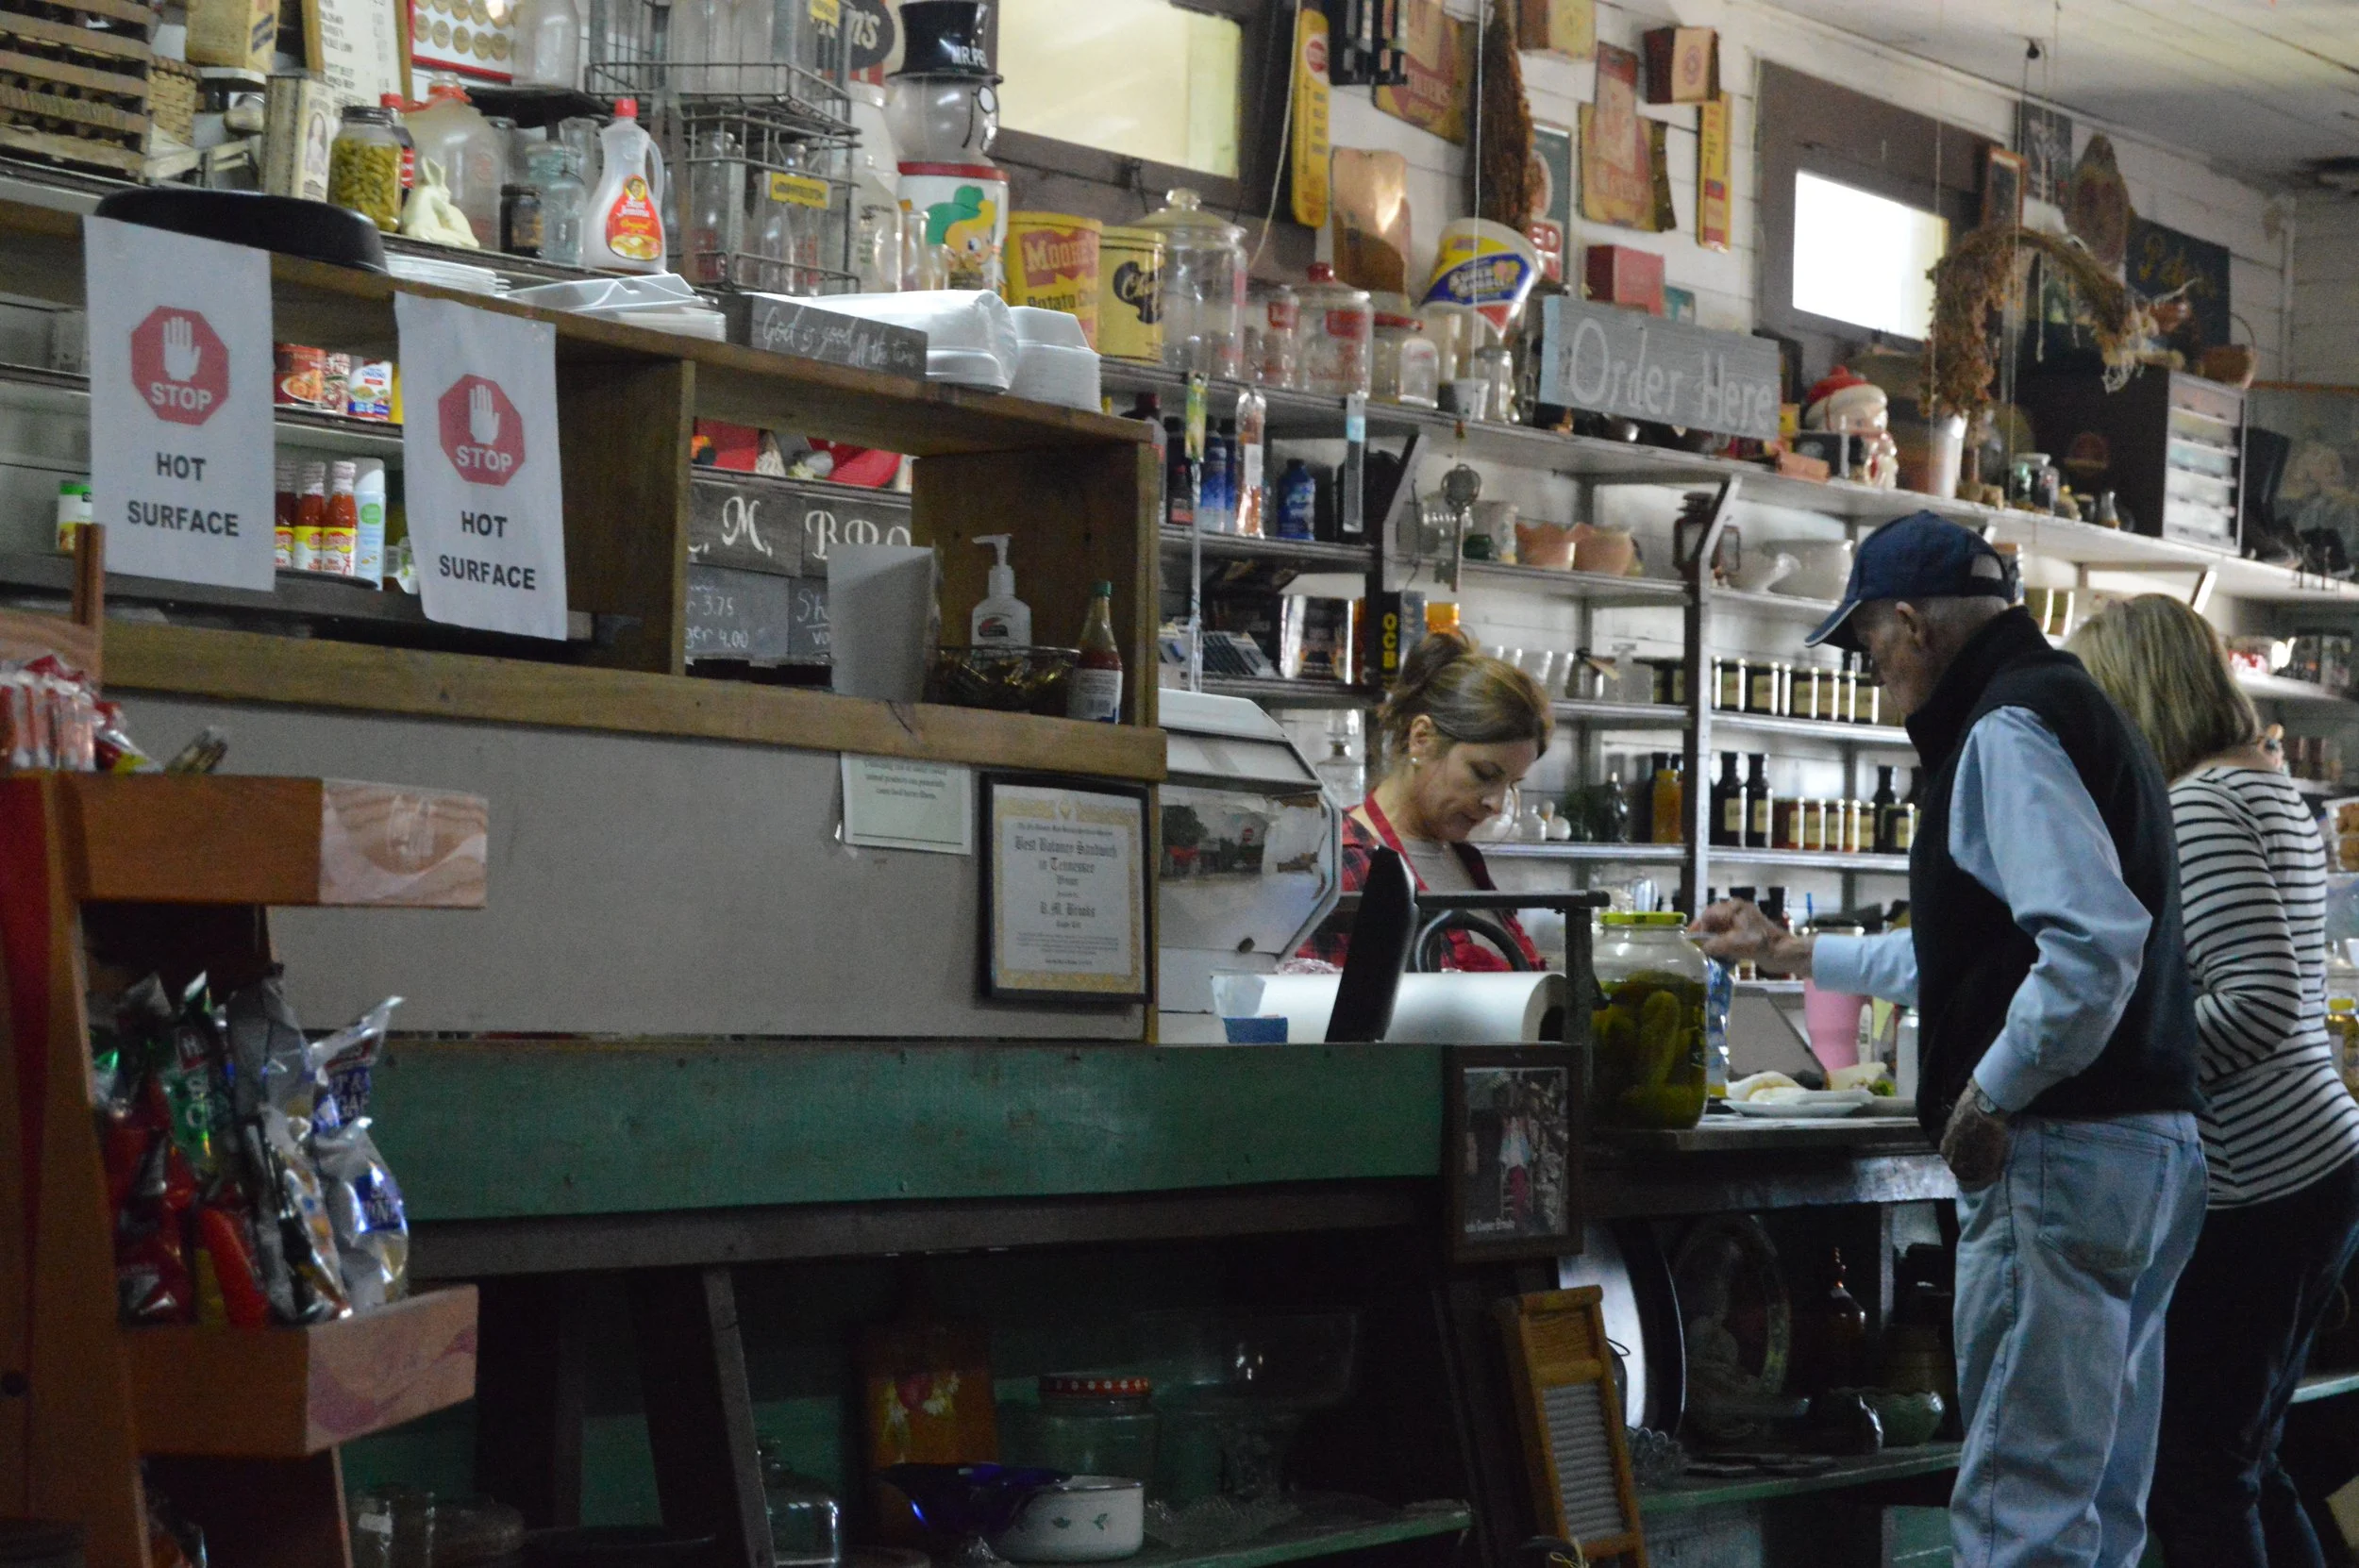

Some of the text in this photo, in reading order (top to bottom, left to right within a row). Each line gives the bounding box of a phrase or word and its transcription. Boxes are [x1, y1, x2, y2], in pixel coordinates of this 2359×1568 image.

[762, 305, 805, 350] God
[813, 316, 859, 359] good
[1569, 317, 1774, 433] Order Here
[150, 381, 213, 412] STOP
[156, 451, 206, 482] HOT
[456, 443, 513, 475] STOP
[126, 499, 240, 538] SURFACE
[460, 509, 508, 539] HOT
[438, 554, 536, 591] SURFACE
[702, 595, 735, 617] 3.75
[718, 627, 749, 649] 4.00
[1013, 836, 1036, 853] Best
[1076, 841, 1118, 859] Sandwich
[1049, 856, 1096, 874] Tennessee
